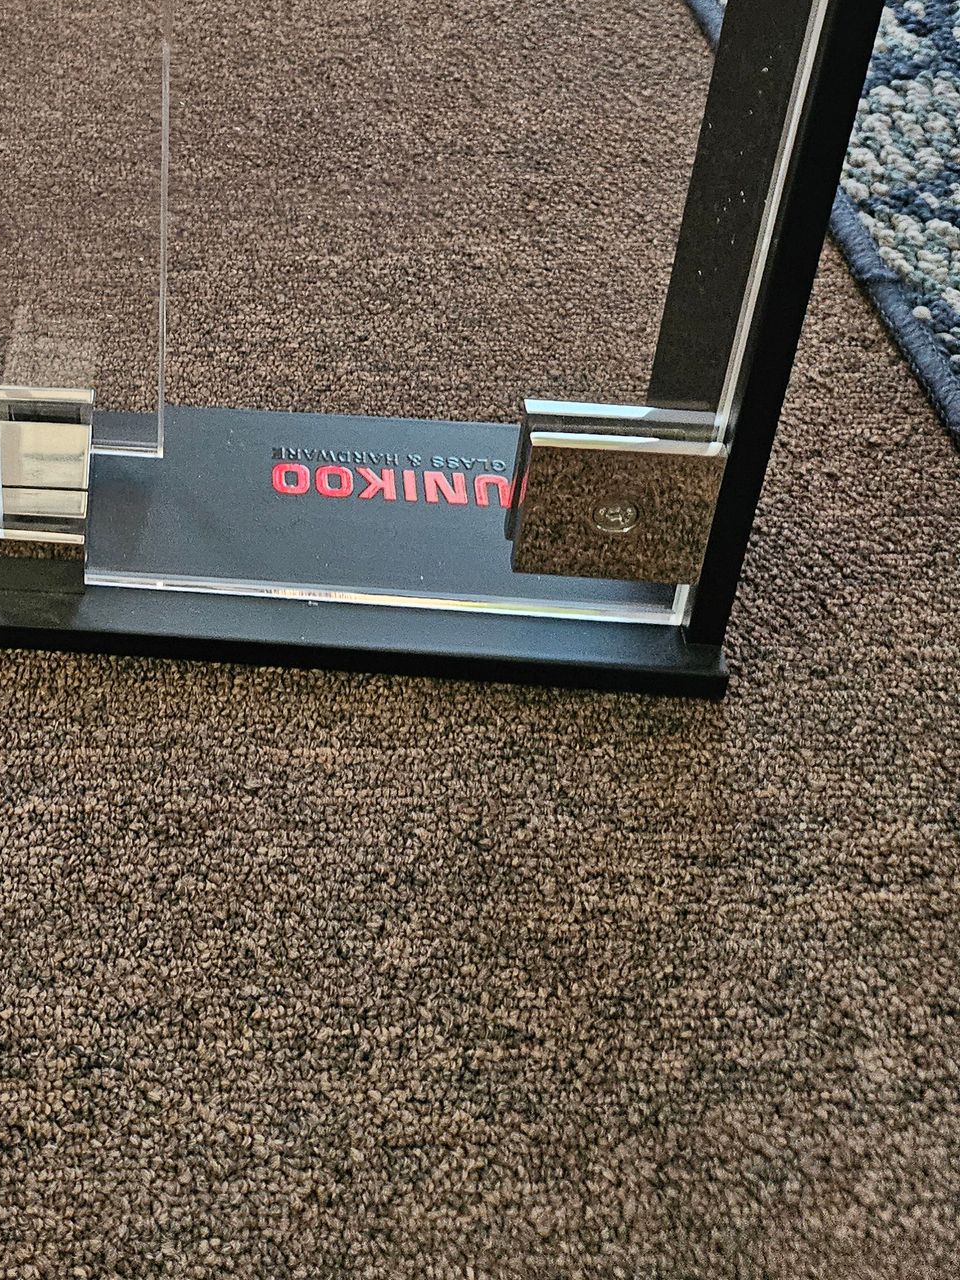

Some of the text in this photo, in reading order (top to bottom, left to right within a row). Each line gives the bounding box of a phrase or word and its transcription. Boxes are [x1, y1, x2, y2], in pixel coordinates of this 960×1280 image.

[272, 446, 507, 472] GLASS & HARDWARE
[272, 463, 512, 509] UNIKOO
